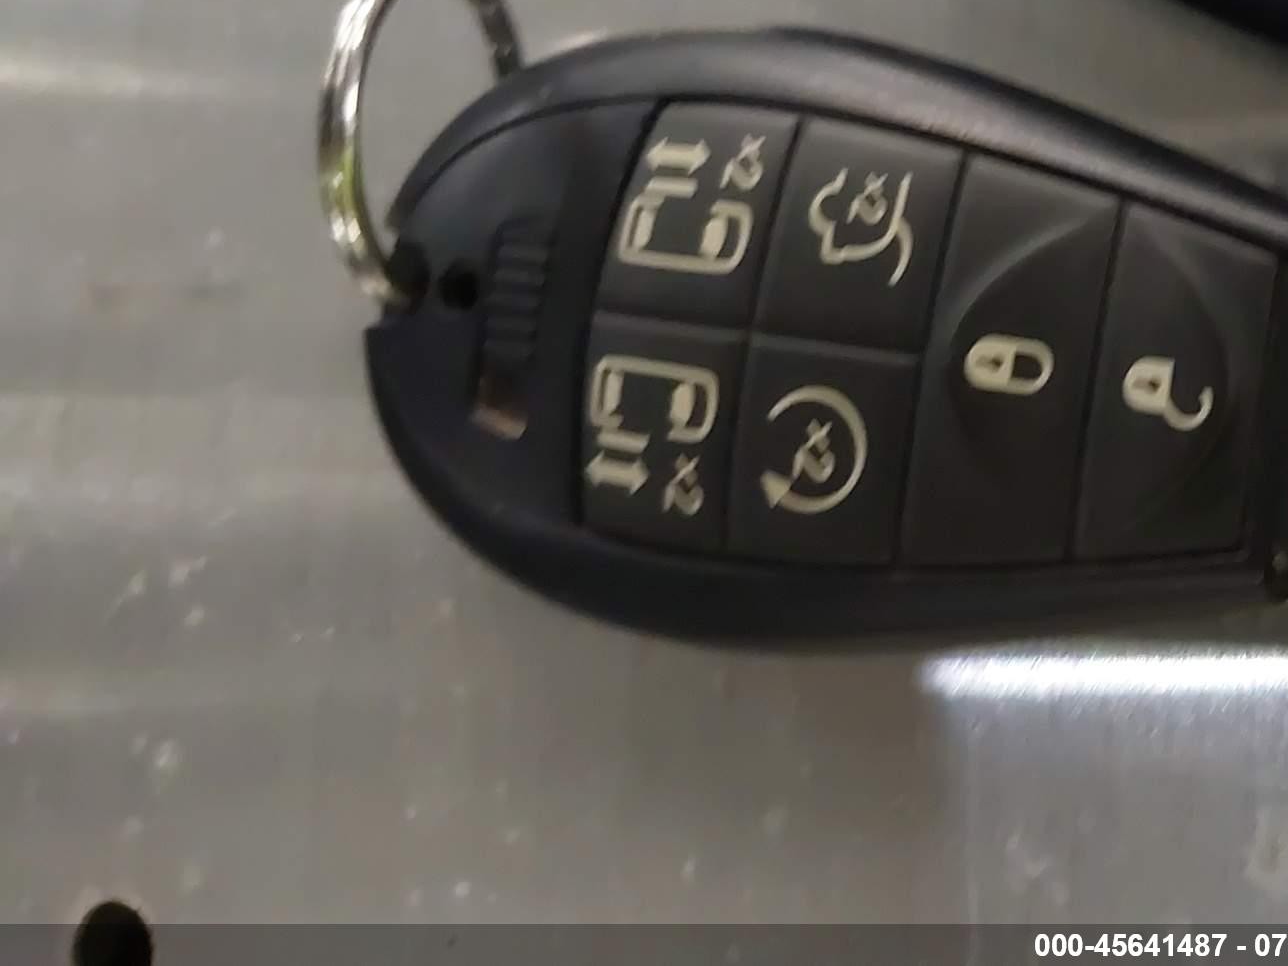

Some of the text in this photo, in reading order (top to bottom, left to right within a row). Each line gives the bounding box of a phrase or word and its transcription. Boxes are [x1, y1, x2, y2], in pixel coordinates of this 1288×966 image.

[720, 133, 766, 191] x2
[846, 171, 889, 226] x2
[793, 418, 836, 483] x2
[663, 454, 704, 516] x2
